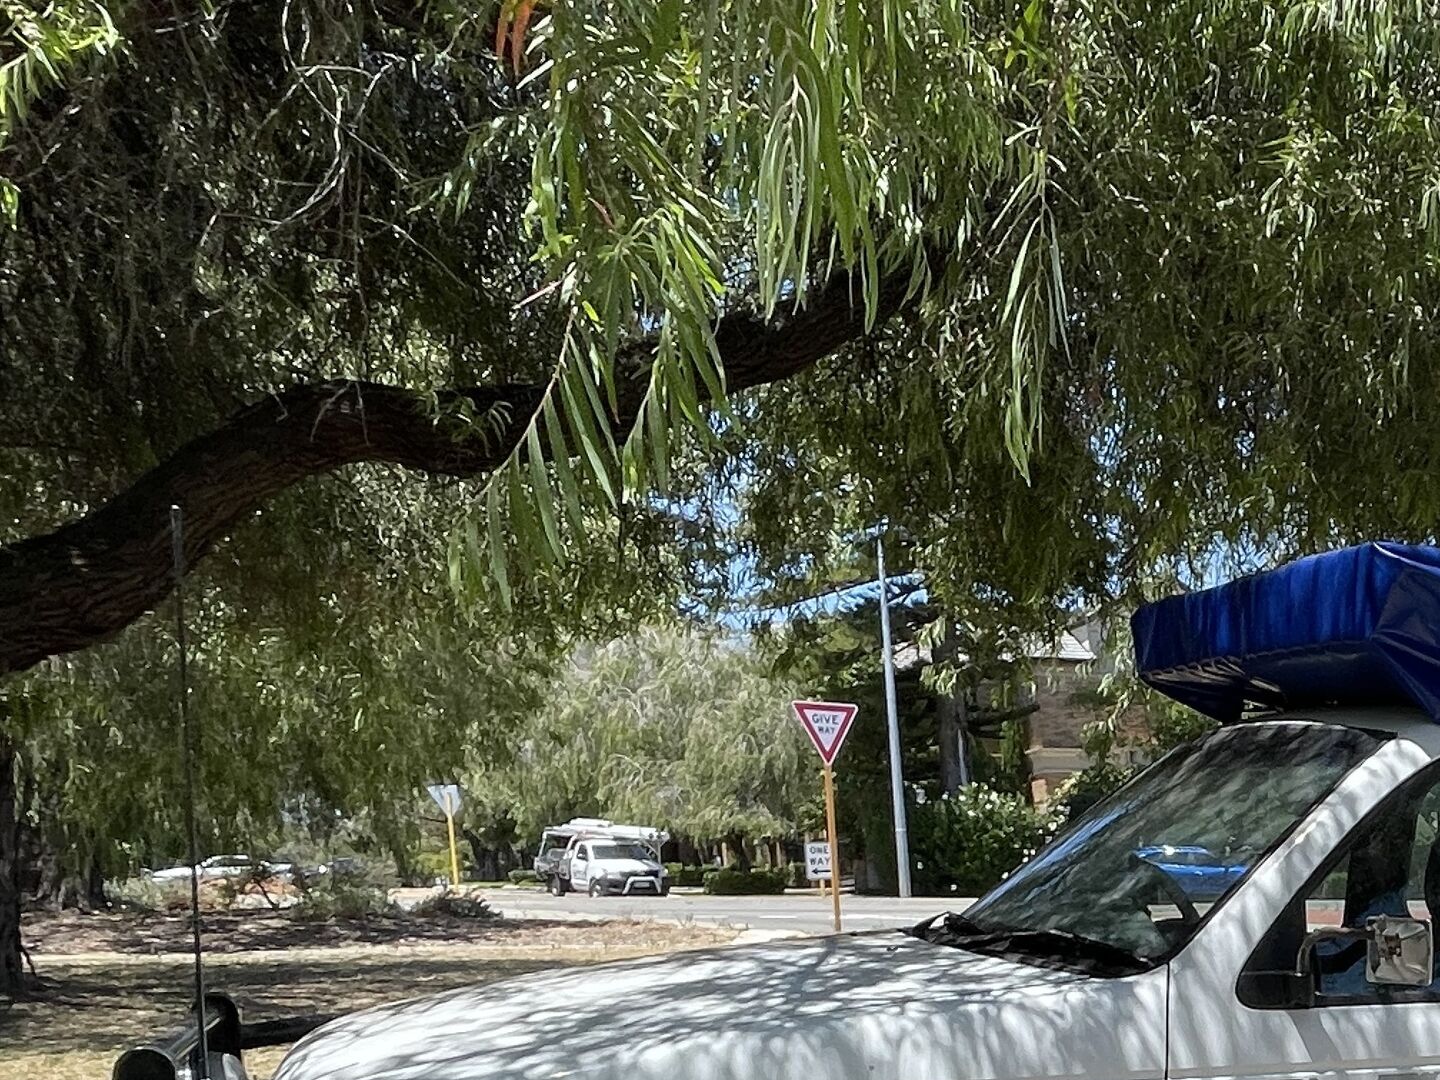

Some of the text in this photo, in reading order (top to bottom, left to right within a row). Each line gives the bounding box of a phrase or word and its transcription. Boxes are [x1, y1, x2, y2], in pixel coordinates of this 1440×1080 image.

[812, 713, 839, 725] GIVE
[818, 726, 835, 734] WAY
[809, 845, 828, 854] ONE
[810, 857, 830, 865] WAY
